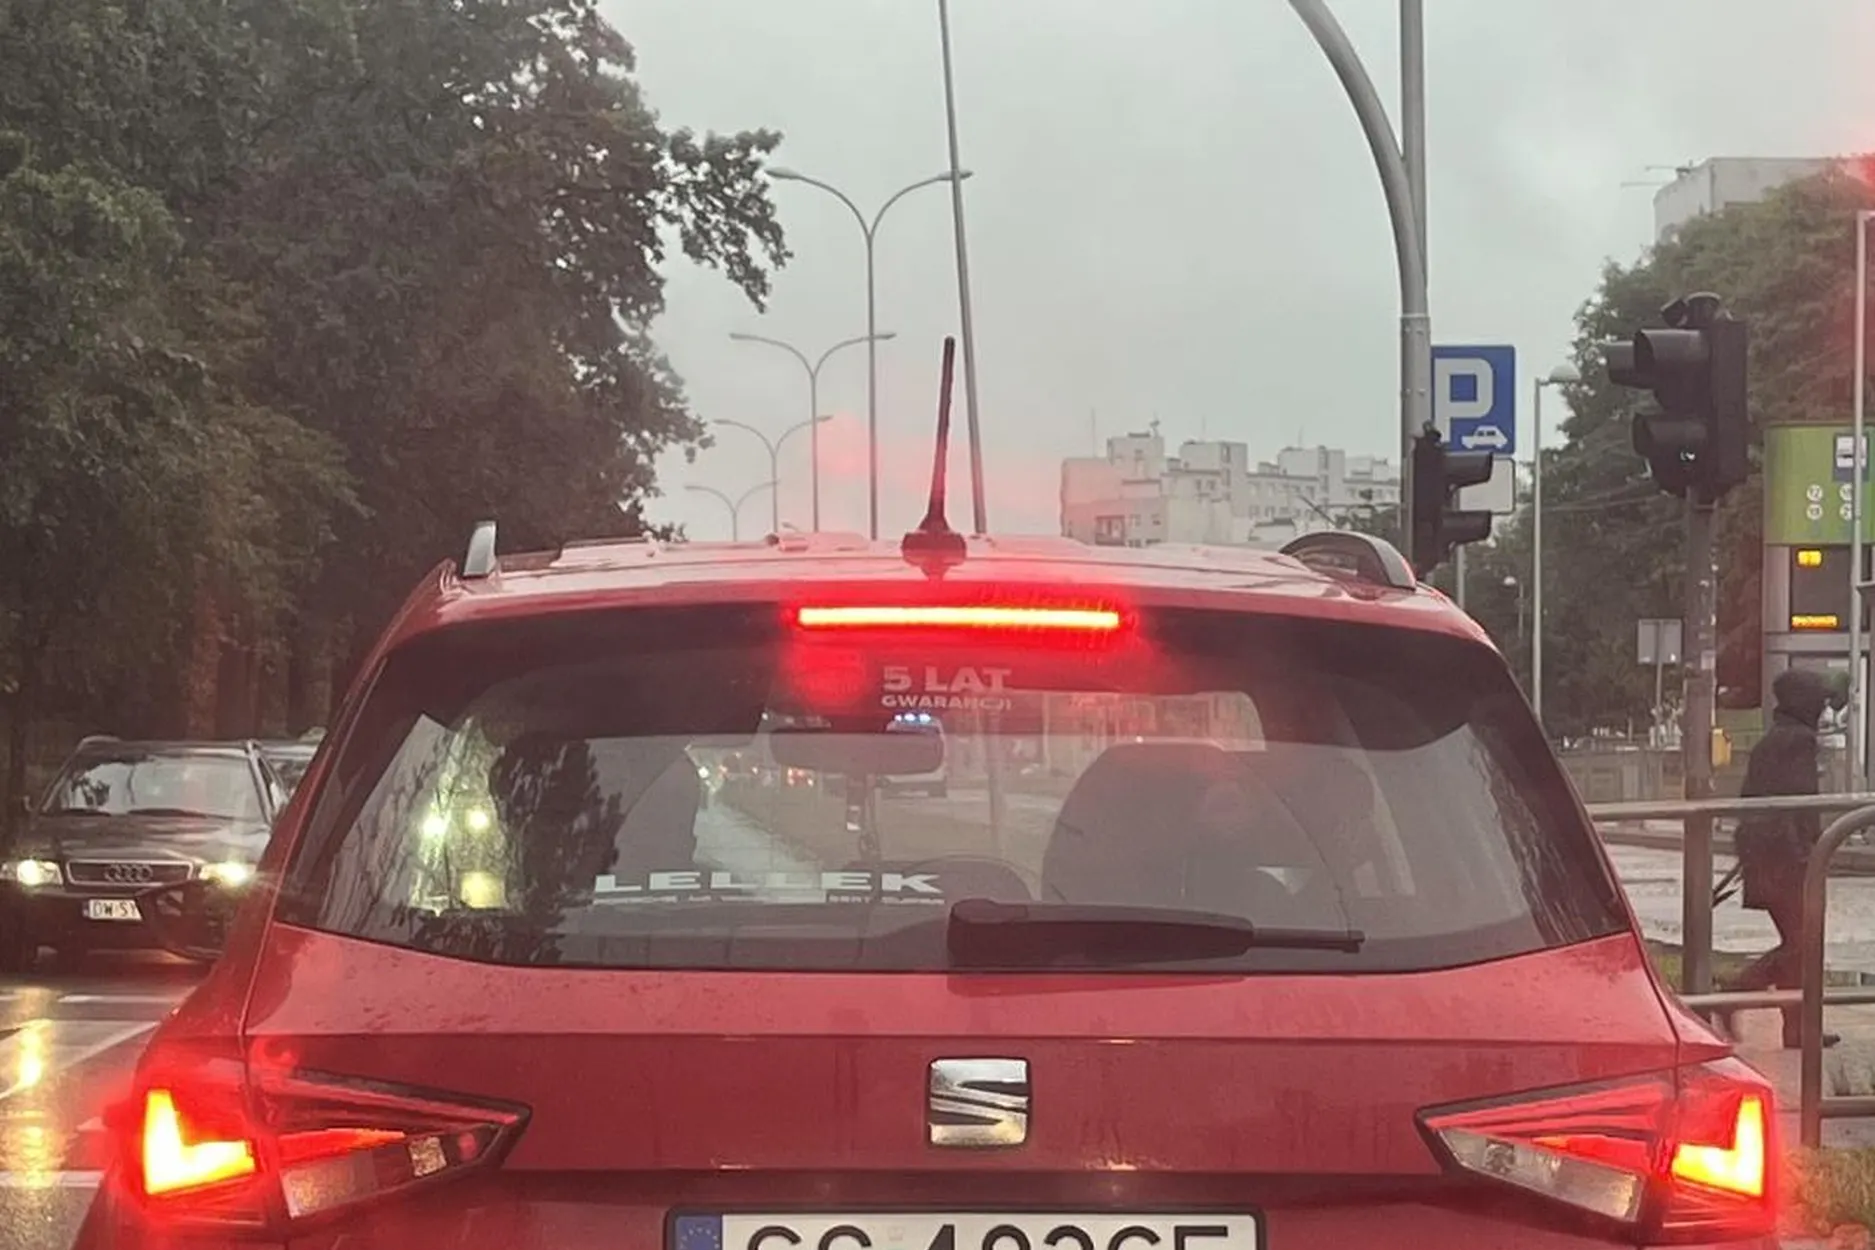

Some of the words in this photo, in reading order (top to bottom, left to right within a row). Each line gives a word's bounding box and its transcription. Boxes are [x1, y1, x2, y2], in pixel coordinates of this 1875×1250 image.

[1434, 357, 1494, 444] P
[883, 666, 911, 692] 5
[924, 666, 1012, 692] LAT
[881, 694, 1012, 709] GWARANCJI
[595, 872, 943, 893] LELLEK
